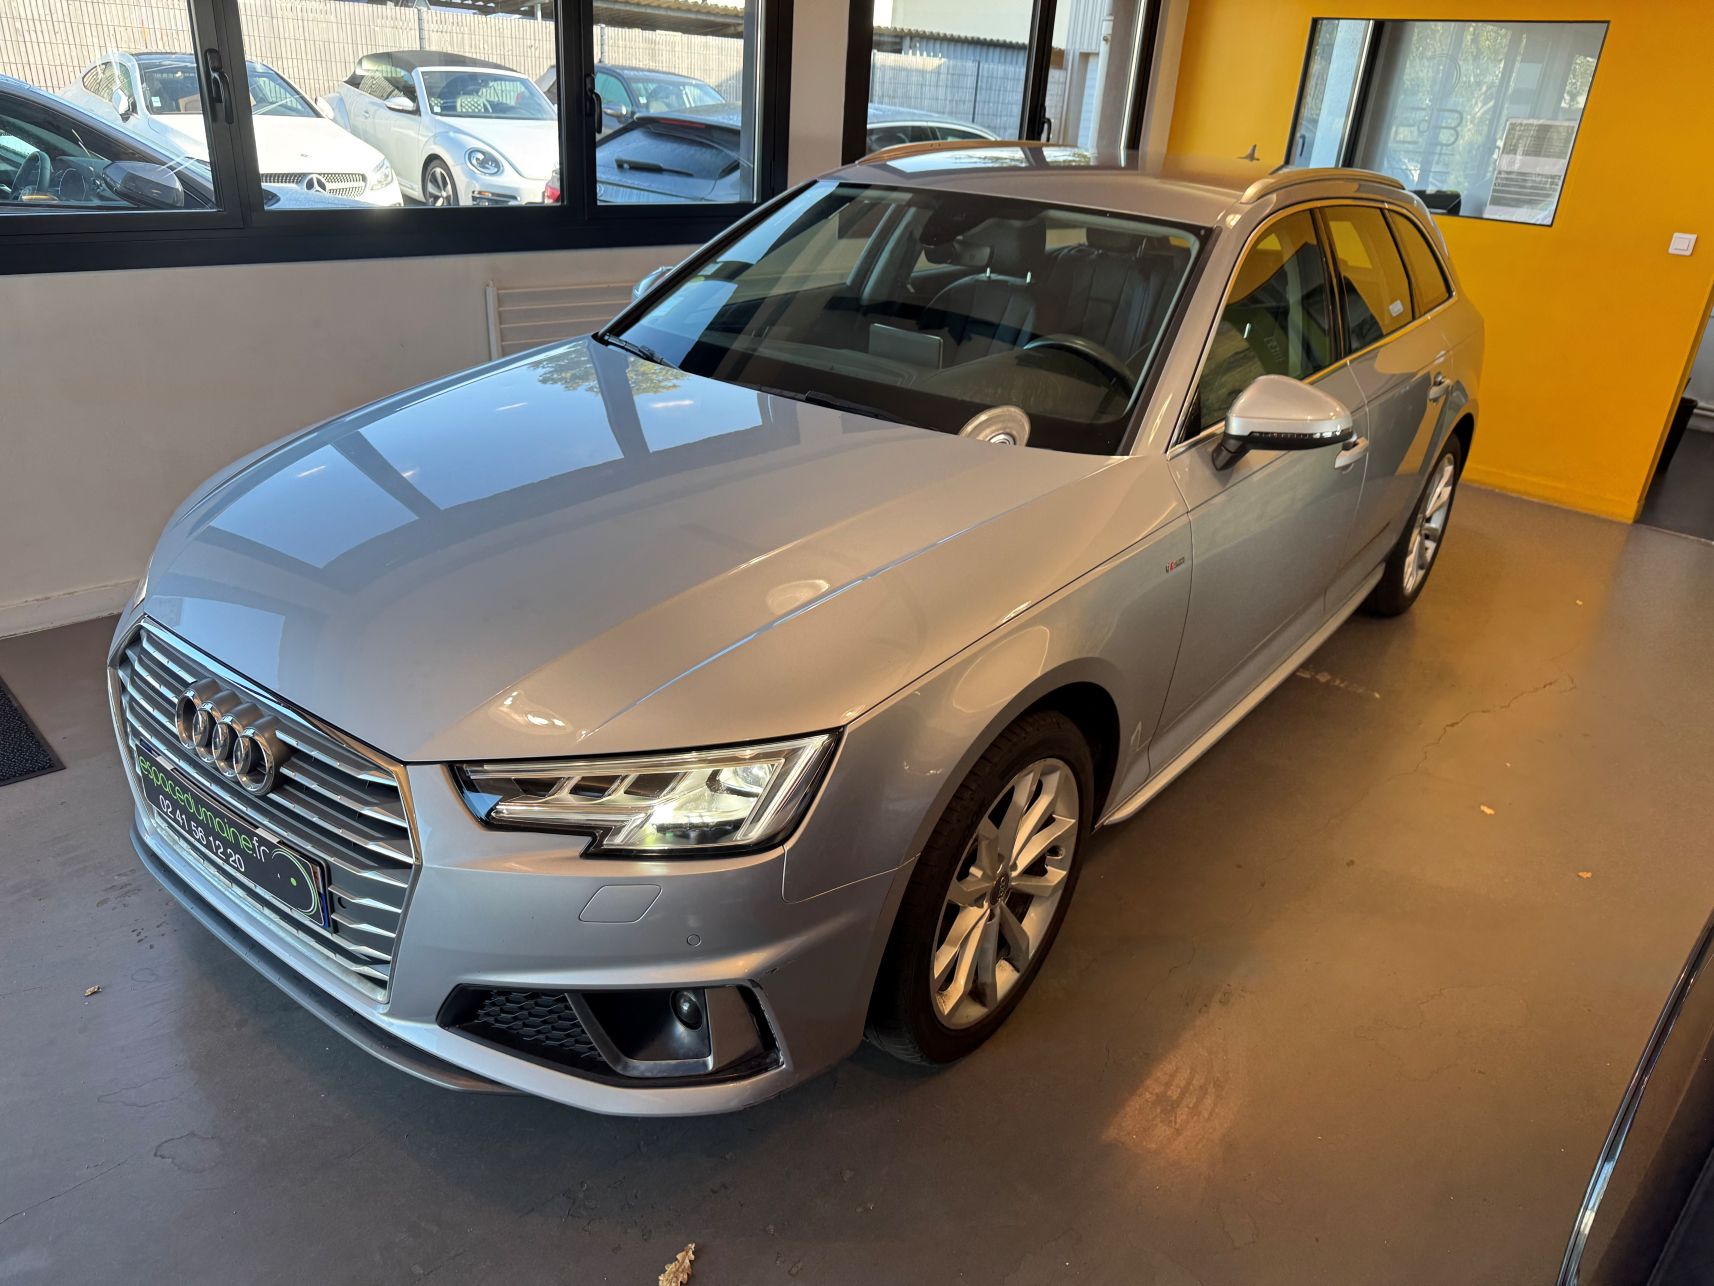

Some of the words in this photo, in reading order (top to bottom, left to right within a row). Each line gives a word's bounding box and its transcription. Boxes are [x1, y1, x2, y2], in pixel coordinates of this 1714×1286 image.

[140, 756, 269, 862] espacedumaine.fr
[159, 795, 174, 819] 02
[175, 809, 188, 831] 41
[191, 821, 206, 845] 56
[209, 836, 226, 860] 12
[227, 849, 245, 872] 20
